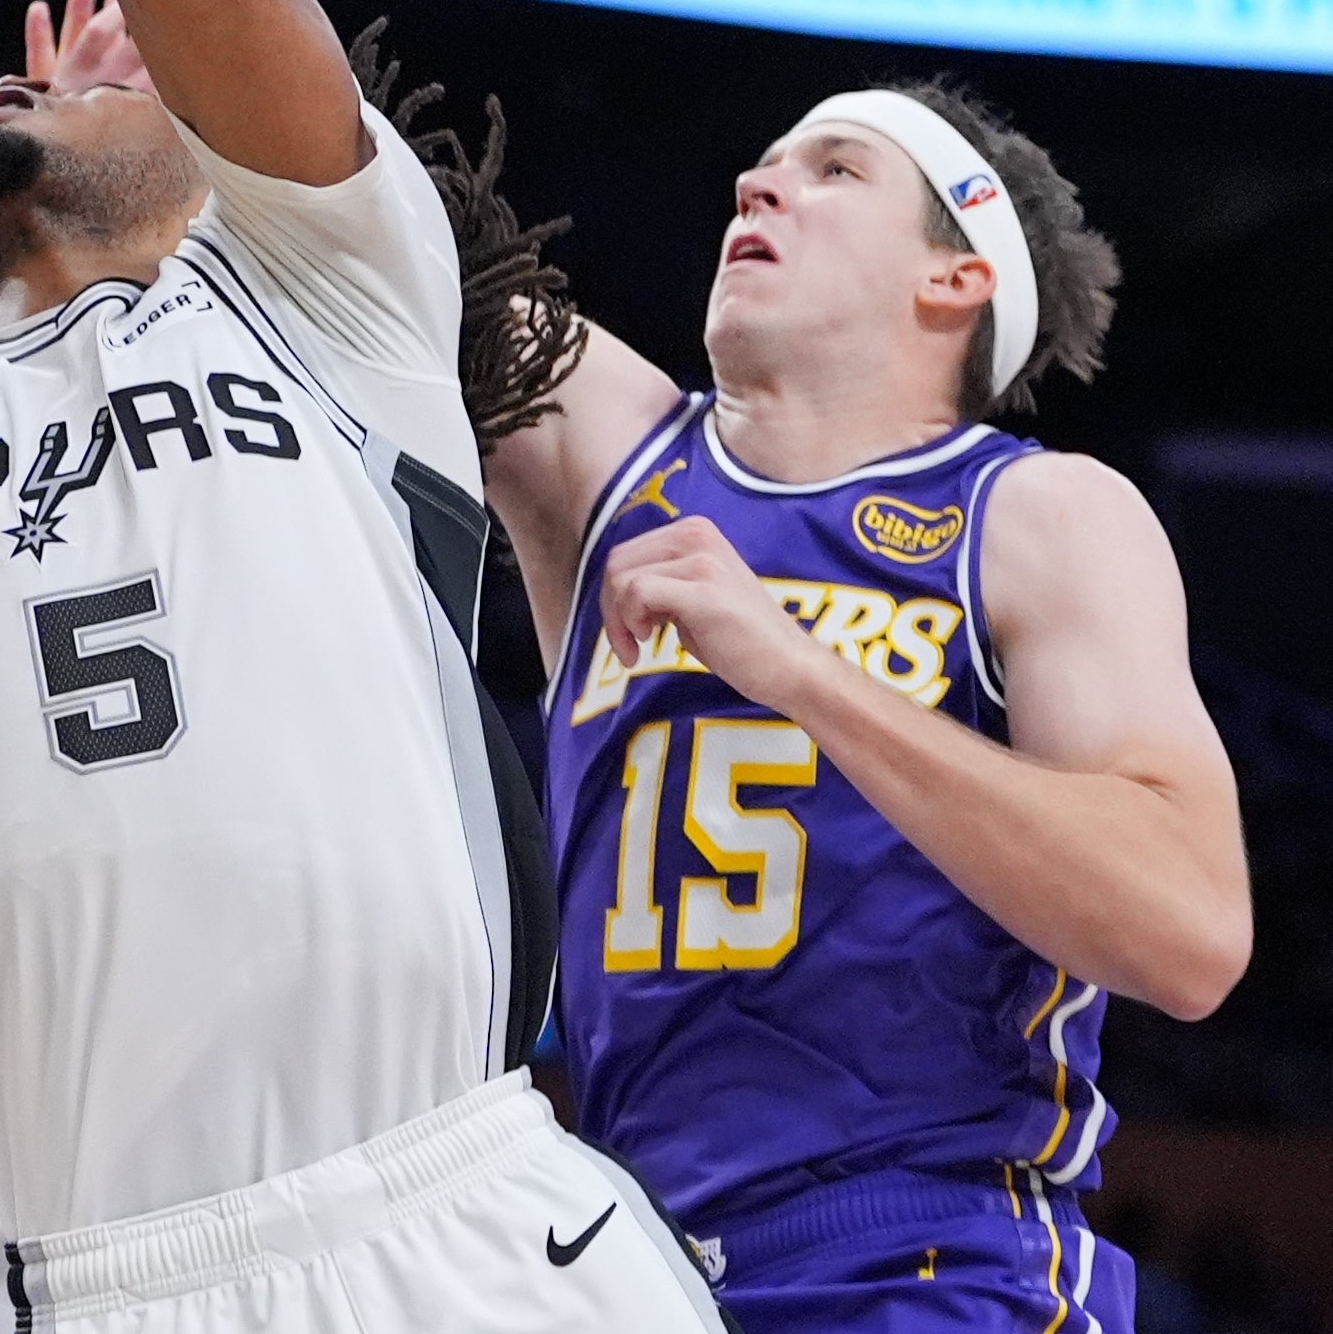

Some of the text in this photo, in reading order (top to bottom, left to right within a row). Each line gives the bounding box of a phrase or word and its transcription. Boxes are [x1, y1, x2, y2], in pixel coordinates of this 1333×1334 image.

[864, 505, 957, 550] bibigo
[23, 568, 187, 775] 5
[571, 577, 965, 727] LERS
[604, 717, 817, 973] 15
